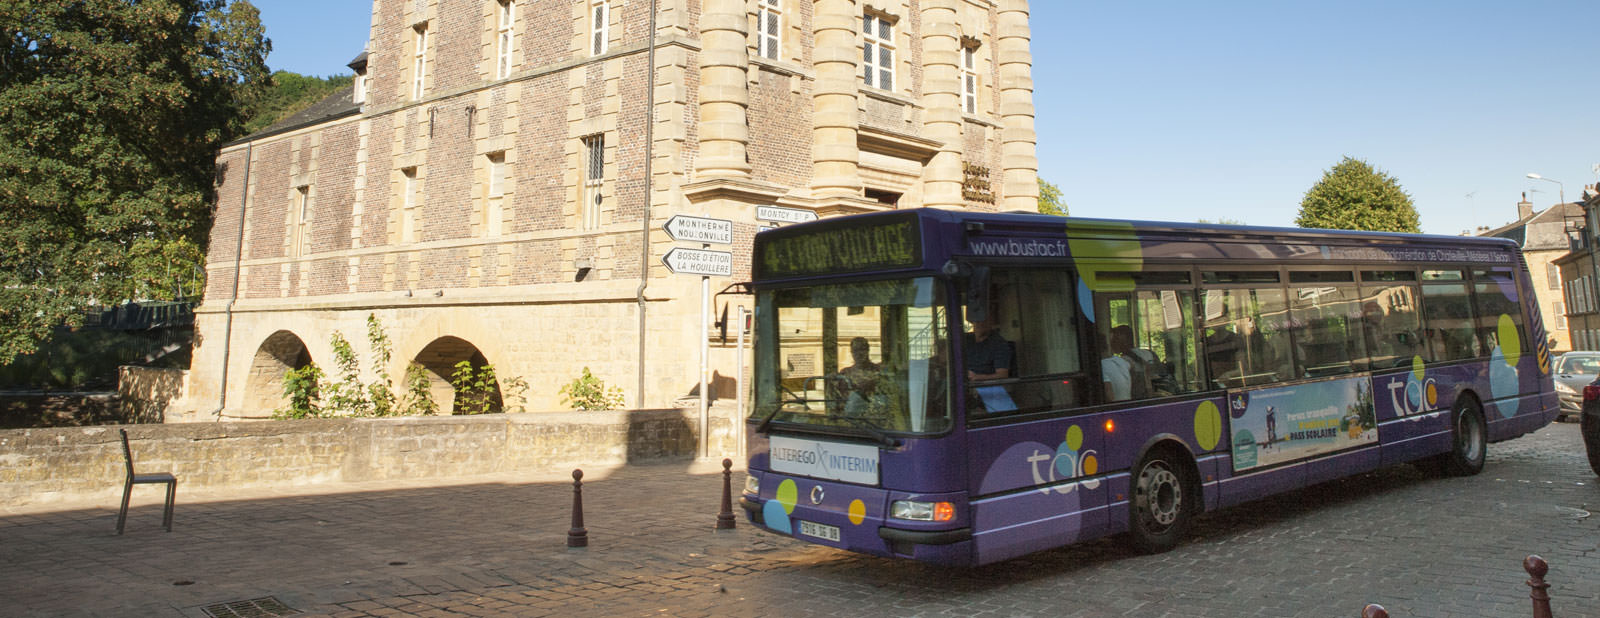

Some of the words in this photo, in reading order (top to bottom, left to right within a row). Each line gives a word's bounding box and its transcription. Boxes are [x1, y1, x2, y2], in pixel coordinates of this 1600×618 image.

[677, 252, 701, 261] BOSSE
[970, 240, 1067, 257] www.bustac.fr
[677, 262, 687, 270] LA
[1387, 376, 1440, 422] tac
[1290, 431, 1305, 440] PASS
[1306, 427, 1336, 439] SCOLAIRE
[772, 447, 816, 465] ALTEREGO
[829, 455, 877, 474] INTERIM
[1027, 450, 1100, 494] tac
